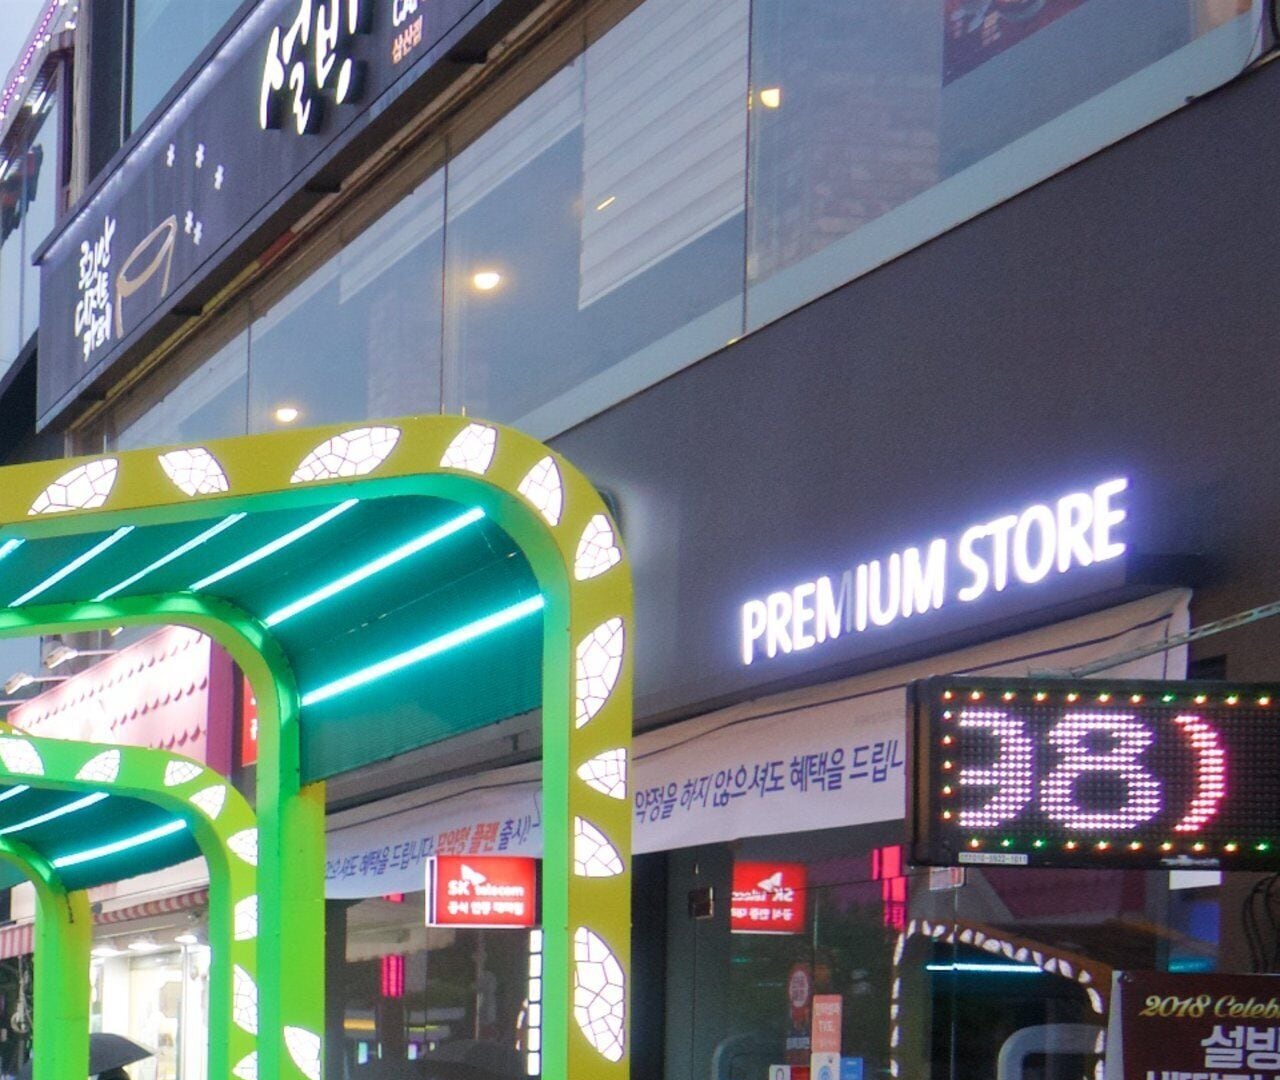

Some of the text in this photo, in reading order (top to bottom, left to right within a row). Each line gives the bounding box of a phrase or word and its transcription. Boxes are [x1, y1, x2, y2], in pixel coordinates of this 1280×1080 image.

[82, 301, 113, 363] 카페
[741, 478, 1130, 665] PREMIUM STORE
[635, 782, 679, 824] 약정을
[680, 773, 713, 811] 하지
[713, 760, 784, 808] 않으셔도
[789, 748, 845, 793] 혜택을
[326, 855, 360, 881] 으셔도
[359, 846, 391, 876] 혜택을
[469, 821, 501, 855] 플랜
[448, 880, 526, 897] SK telecom
[448, 902, 468, 916] 공식
[493, 902, 526, 916] 대리점
[1139, 994, 1211, 1018] 2018
